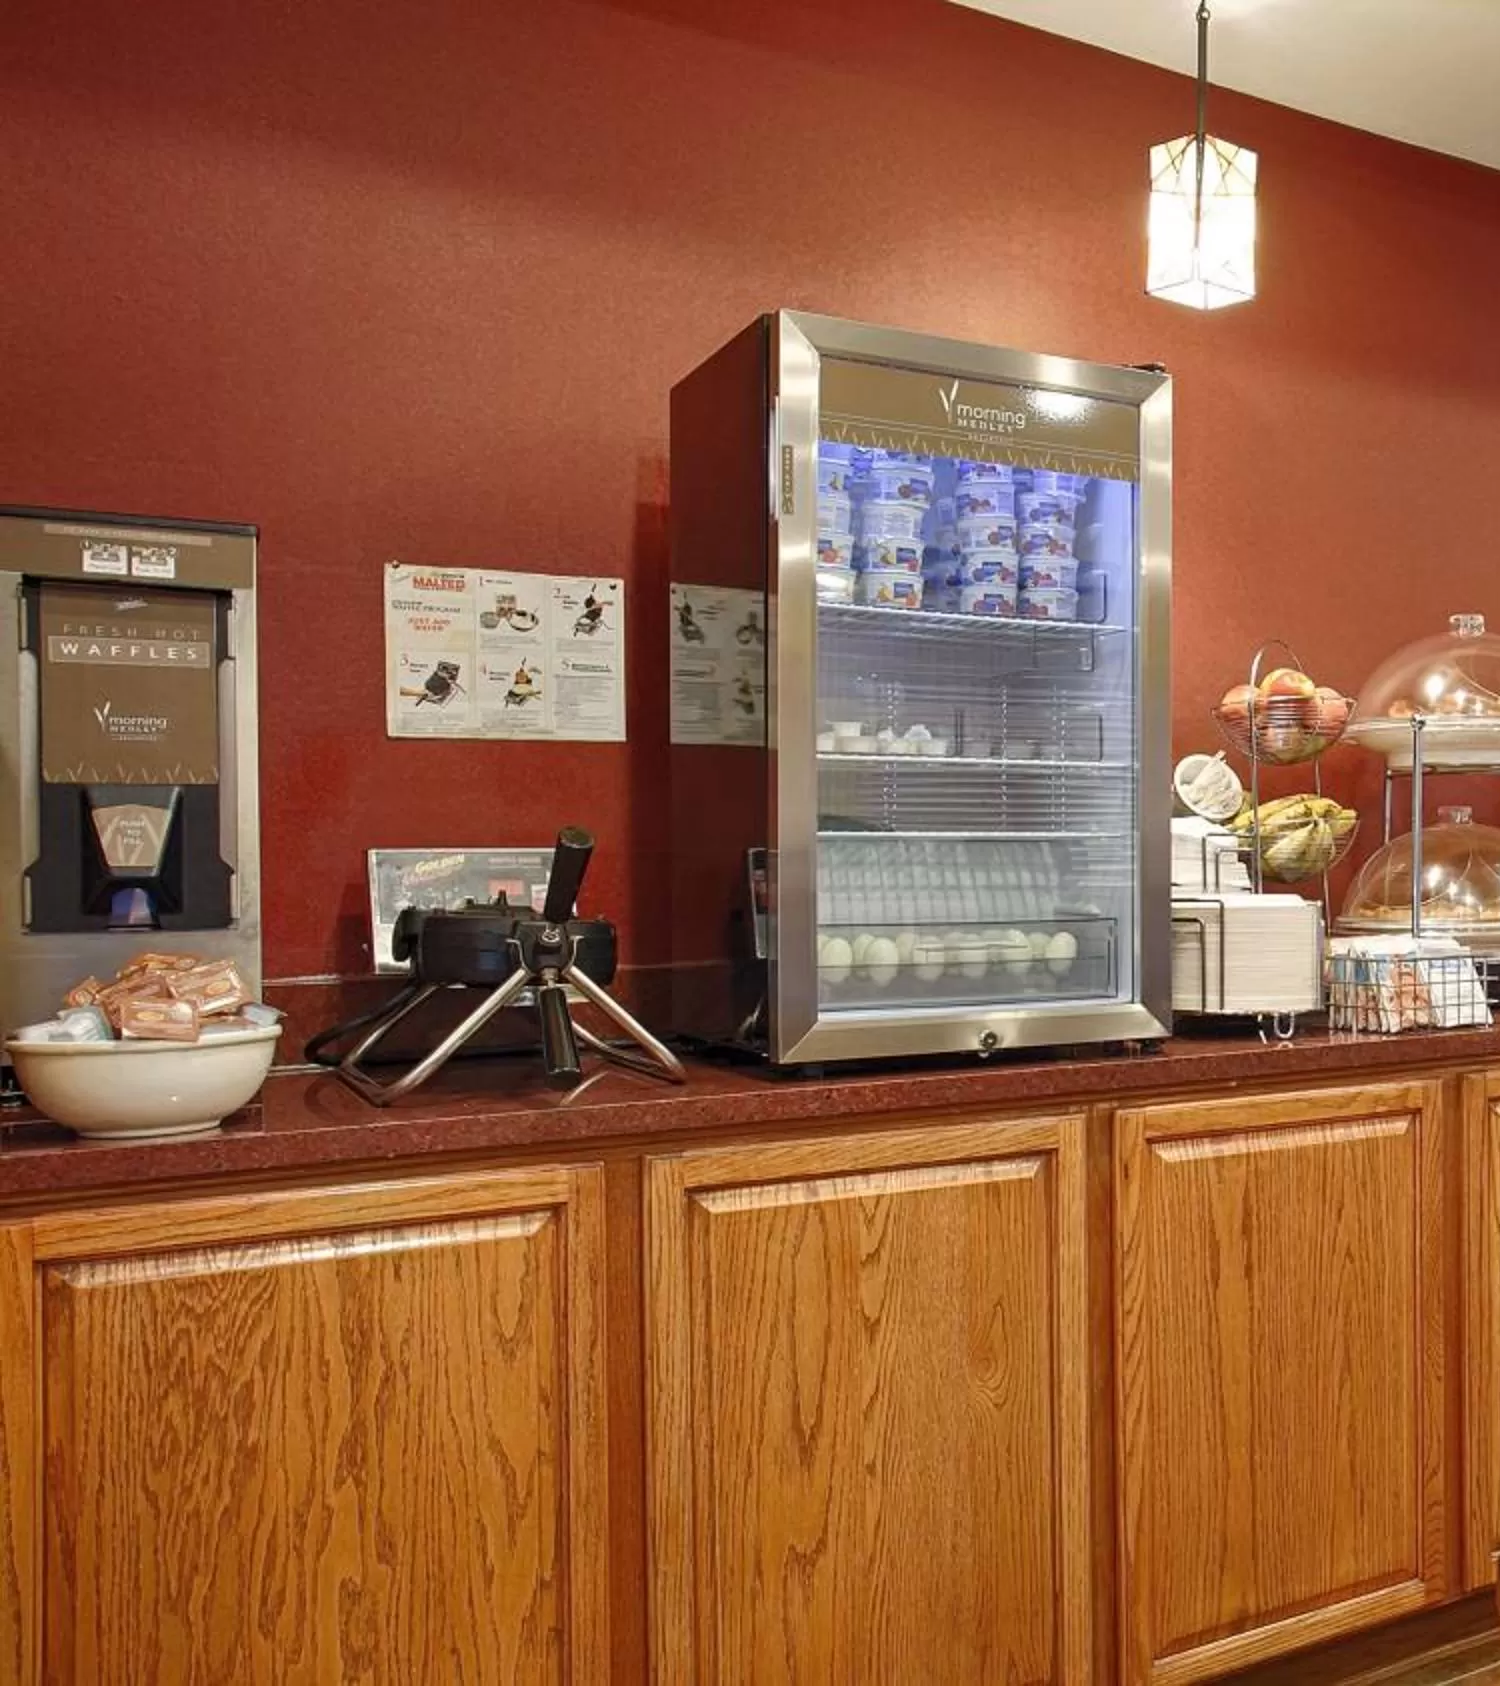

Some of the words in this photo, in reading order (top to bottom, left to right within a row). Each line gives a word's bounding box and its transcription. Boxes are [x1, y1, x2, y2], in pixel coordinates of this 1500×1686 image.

[956, 403, 1026, 430] morning
[412, 575, 466, 591] MALTED
[62, 623, 138, 637] FRESH
[154, 627, 200, 641] HOT
[60, 641, 198, 660] WAFFLES
[108, 716, 168, 729] morning
